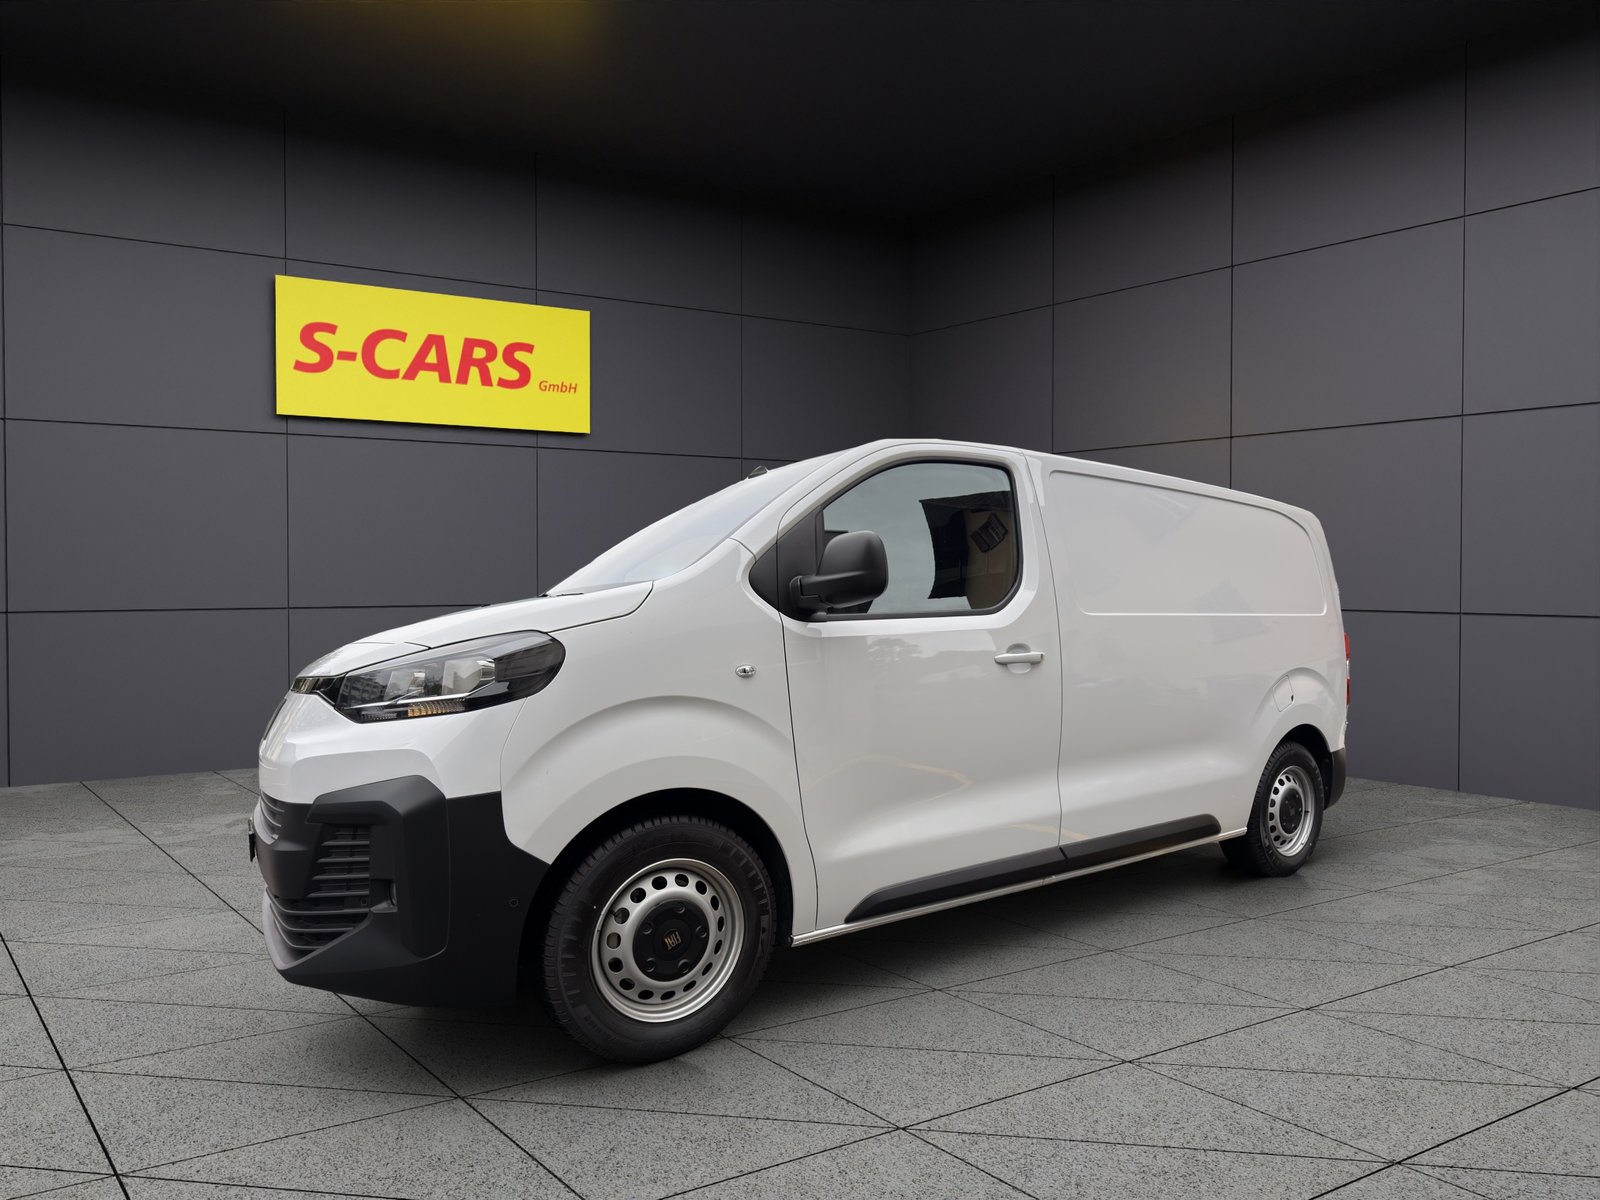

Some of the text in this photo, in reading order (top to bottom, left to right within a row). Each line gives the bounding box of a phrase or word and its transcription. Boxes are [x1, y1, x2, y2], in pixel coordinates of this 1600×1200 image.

[293, 321, 578, 394] S-CARS GmbH
[664, 931, 682, 951] FIAT
